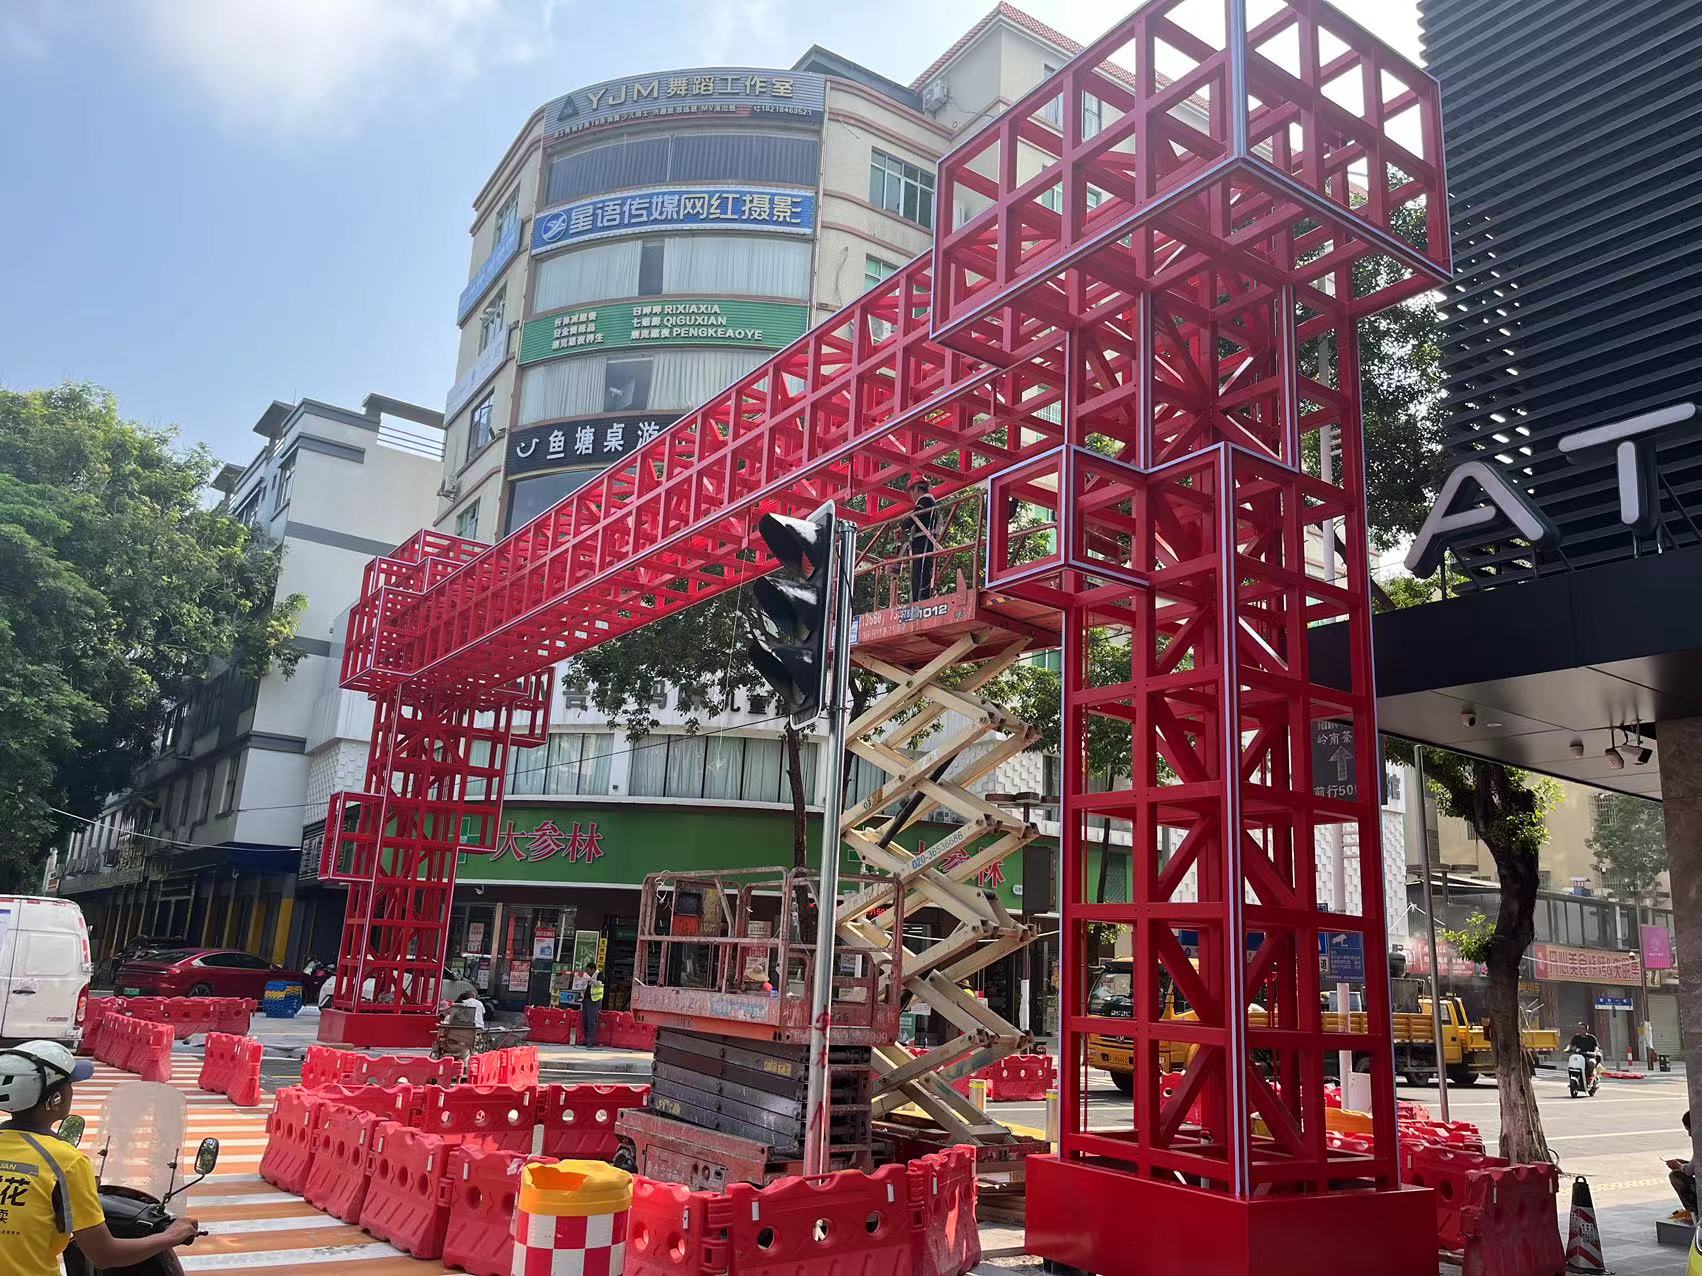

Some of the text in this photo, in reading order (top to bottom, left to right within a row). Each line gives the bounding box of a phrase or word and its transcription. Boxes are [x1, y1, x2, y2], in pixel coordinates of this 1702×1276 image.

[587, 75, 794, 110] YJM 舞蹈工作室
[568, 193, 802, 234] 星语传媒网红摄影
[664, 304, 721, 315] RIXIAXIA
[663, 315, 727, 327] QIGUXIAN
[672, 328, 764, 341] PENGKEAOYE
[1313, 784, 1357, 798] 前行50
[489, 819, 605, 865] 大参林
[0, 1175, 31, 1206] 花
